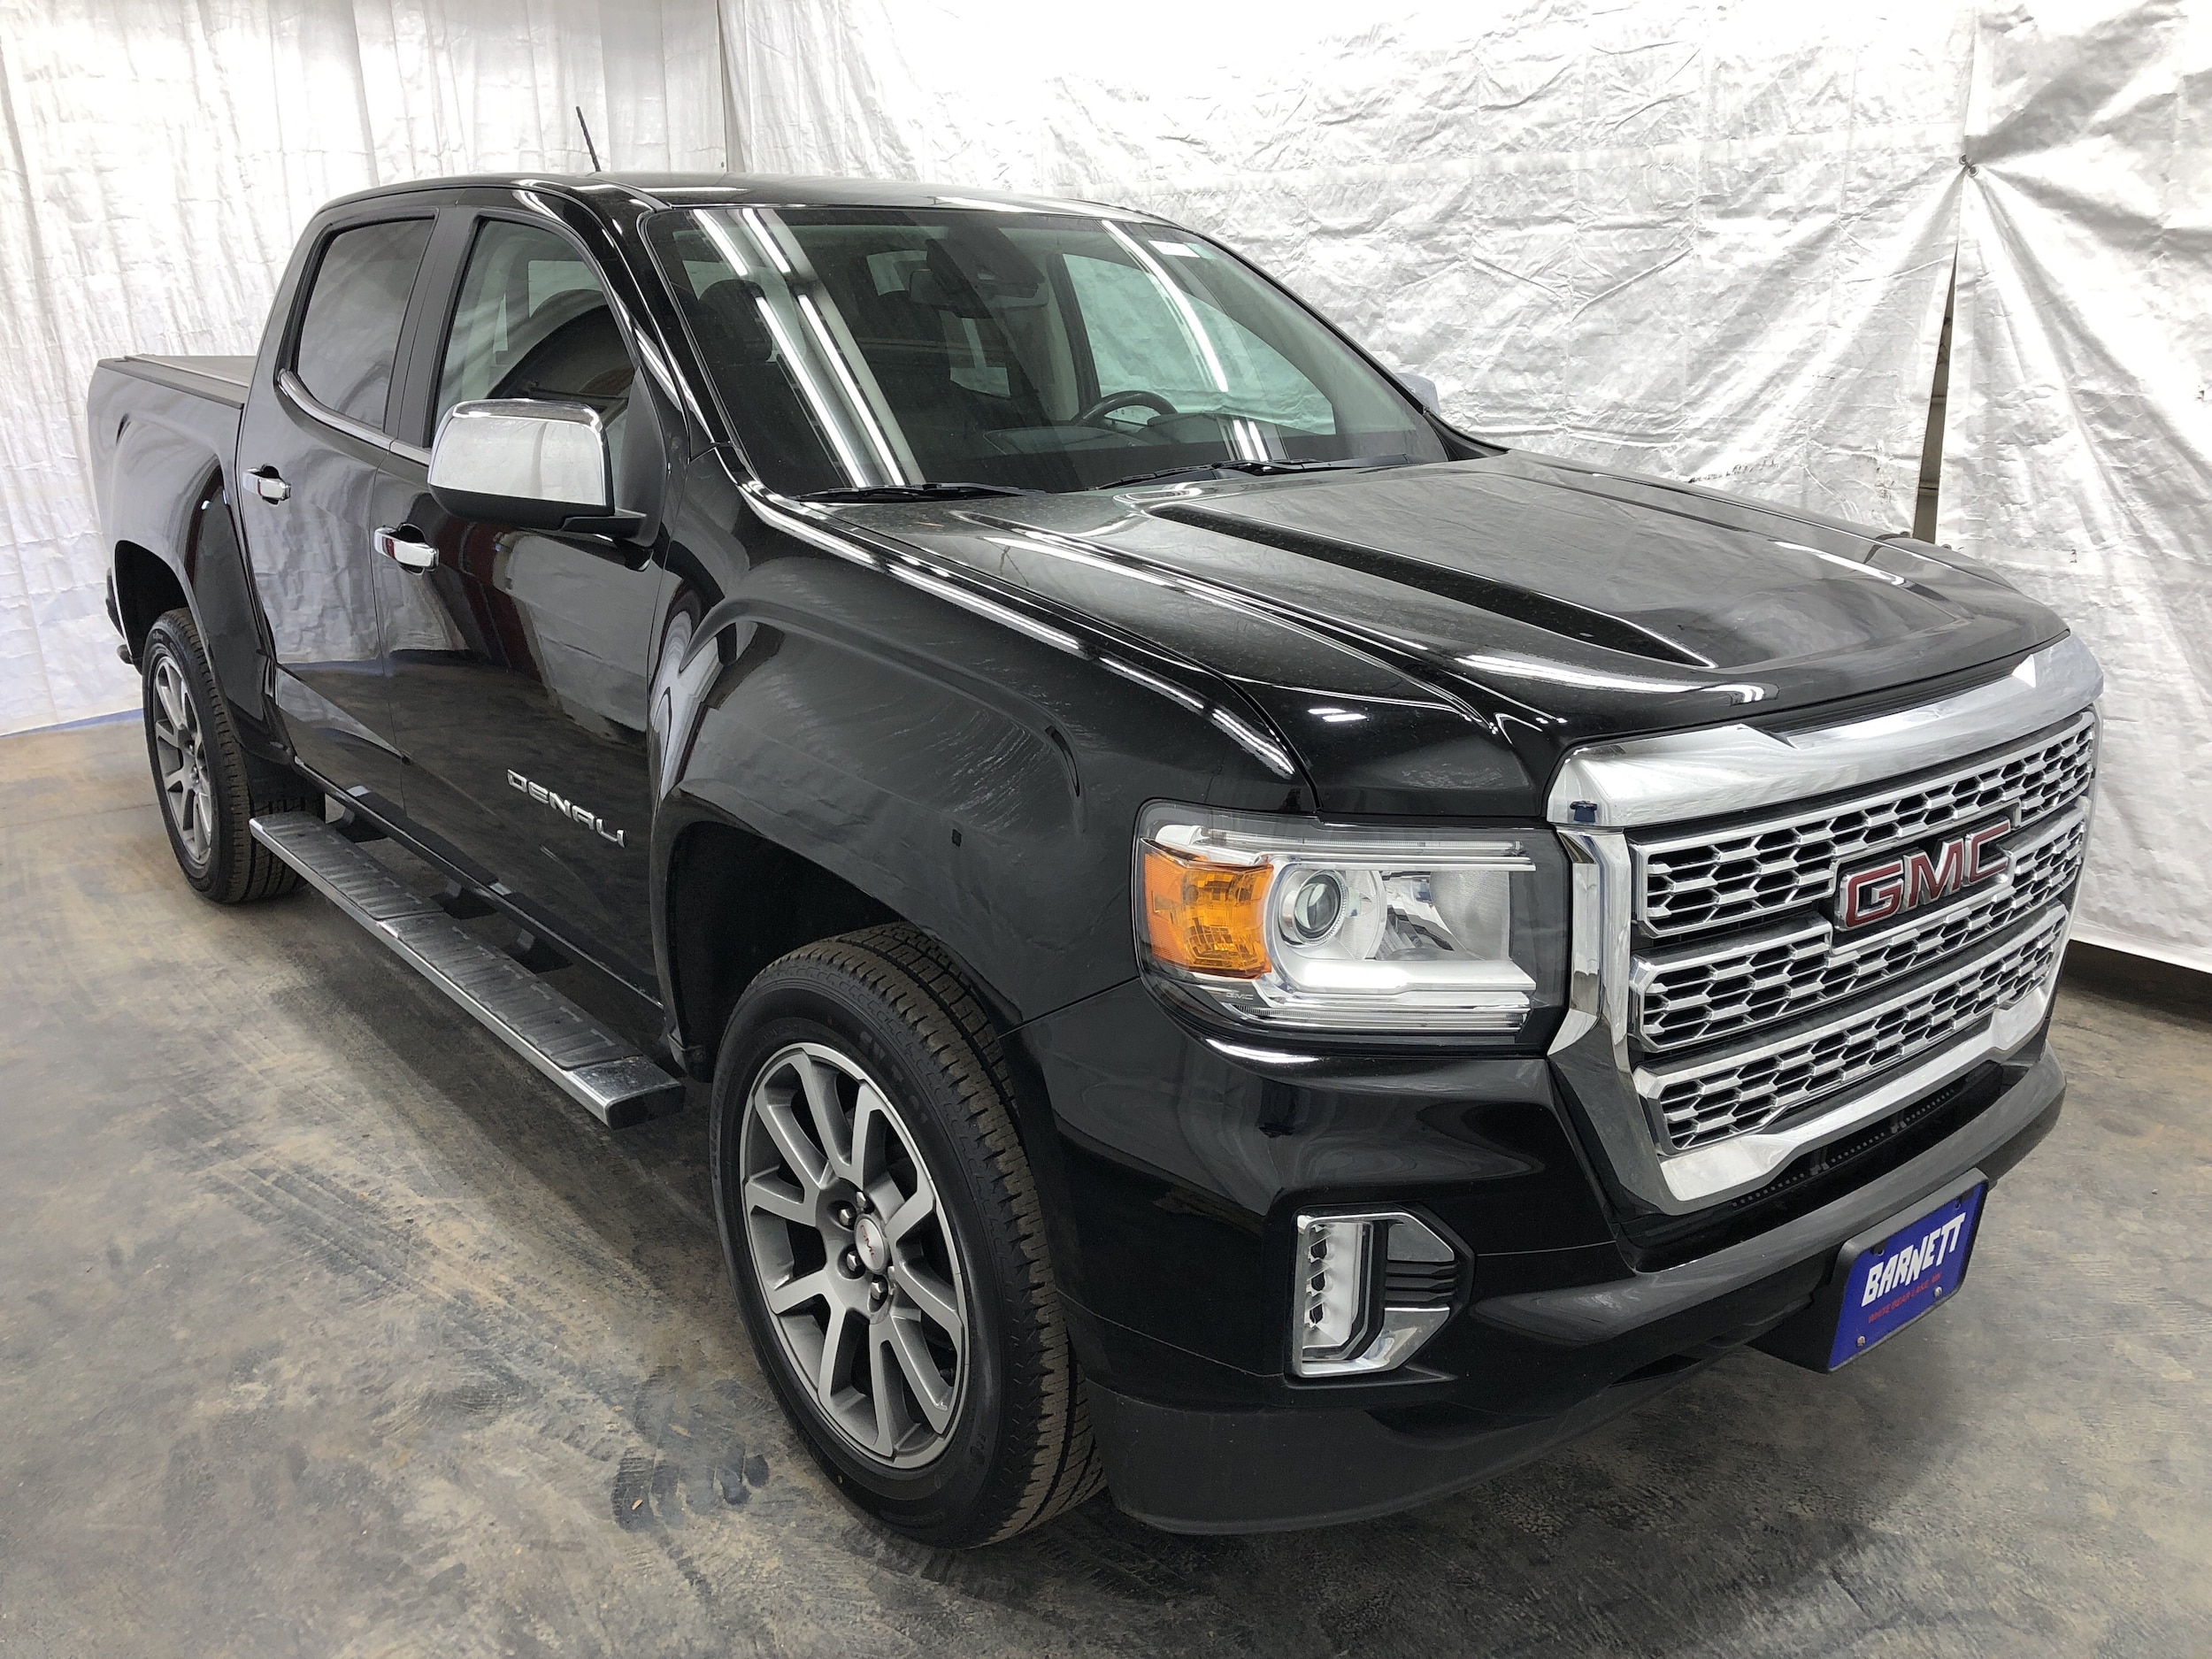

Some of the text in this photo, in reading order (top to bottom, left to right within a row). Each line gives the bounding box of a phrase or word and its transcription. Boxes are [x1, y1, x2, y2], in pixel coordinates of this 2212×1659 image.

[507, 769, 626, 849] DENALI
[1835, 818, 2011, 930] GMC
[1225, 992, 1254, 1001] GMC
[1861, 1212, 1966, 1307] BARNETT
